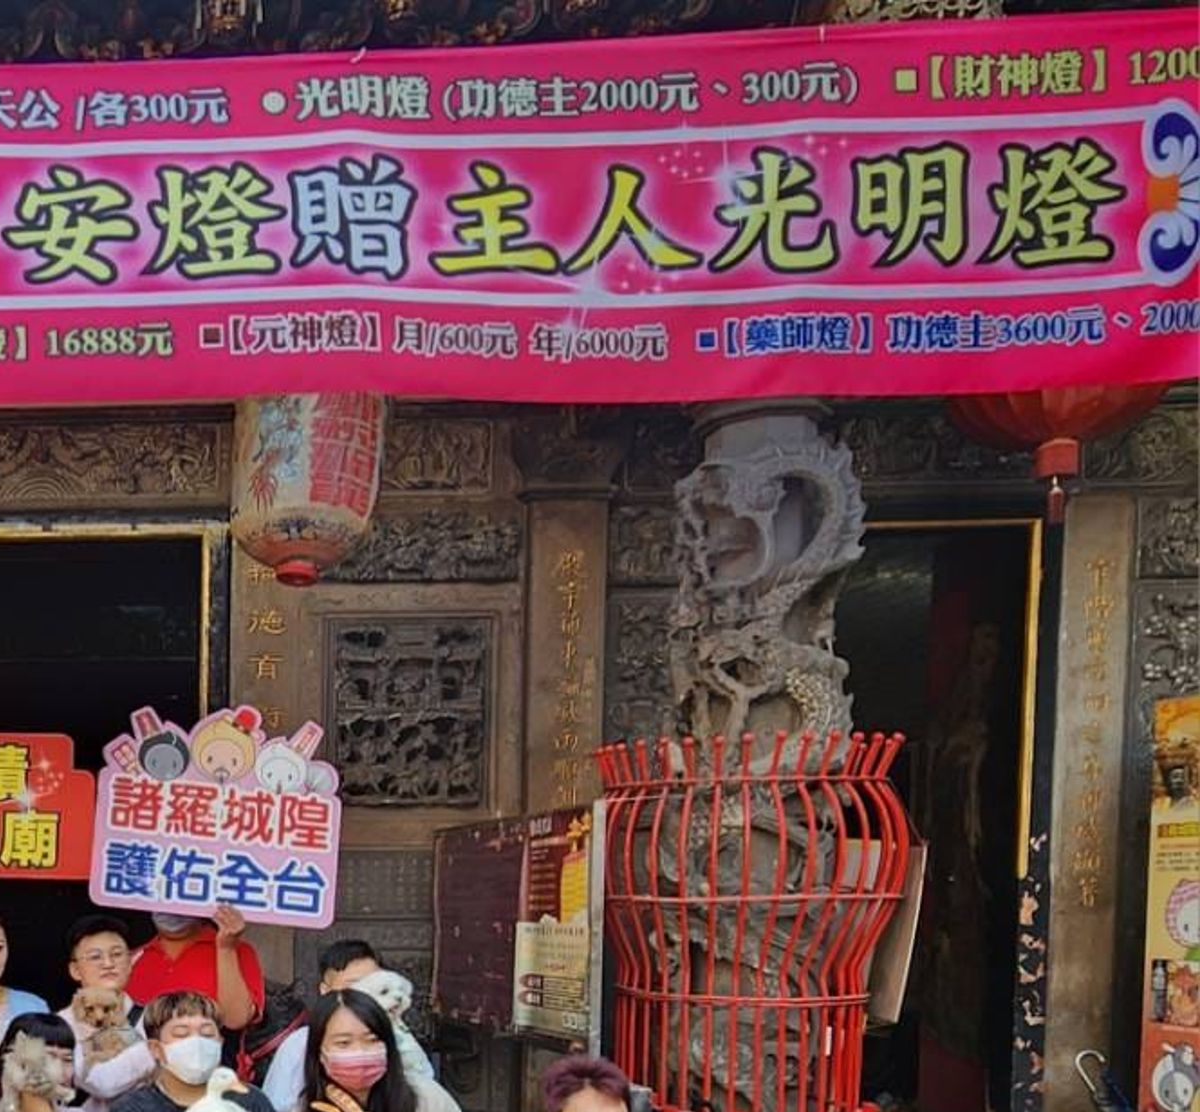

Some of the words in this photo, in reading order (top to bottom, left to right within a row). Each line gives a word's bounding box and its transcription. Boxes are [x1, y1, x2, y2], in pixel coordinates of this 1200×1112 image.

[74, 86, 230, 130] /各300元
[294, 74, 431, 121] 光明燈
[44, 320, 173, 357] 16888元
[393, 319, 516, 358] 月/600元
[531, 320, 668, 361] 年/6000元
[108, 775, 331, 852] 諸羅城隍
[103, 841, 327, 914] 護佑全台
